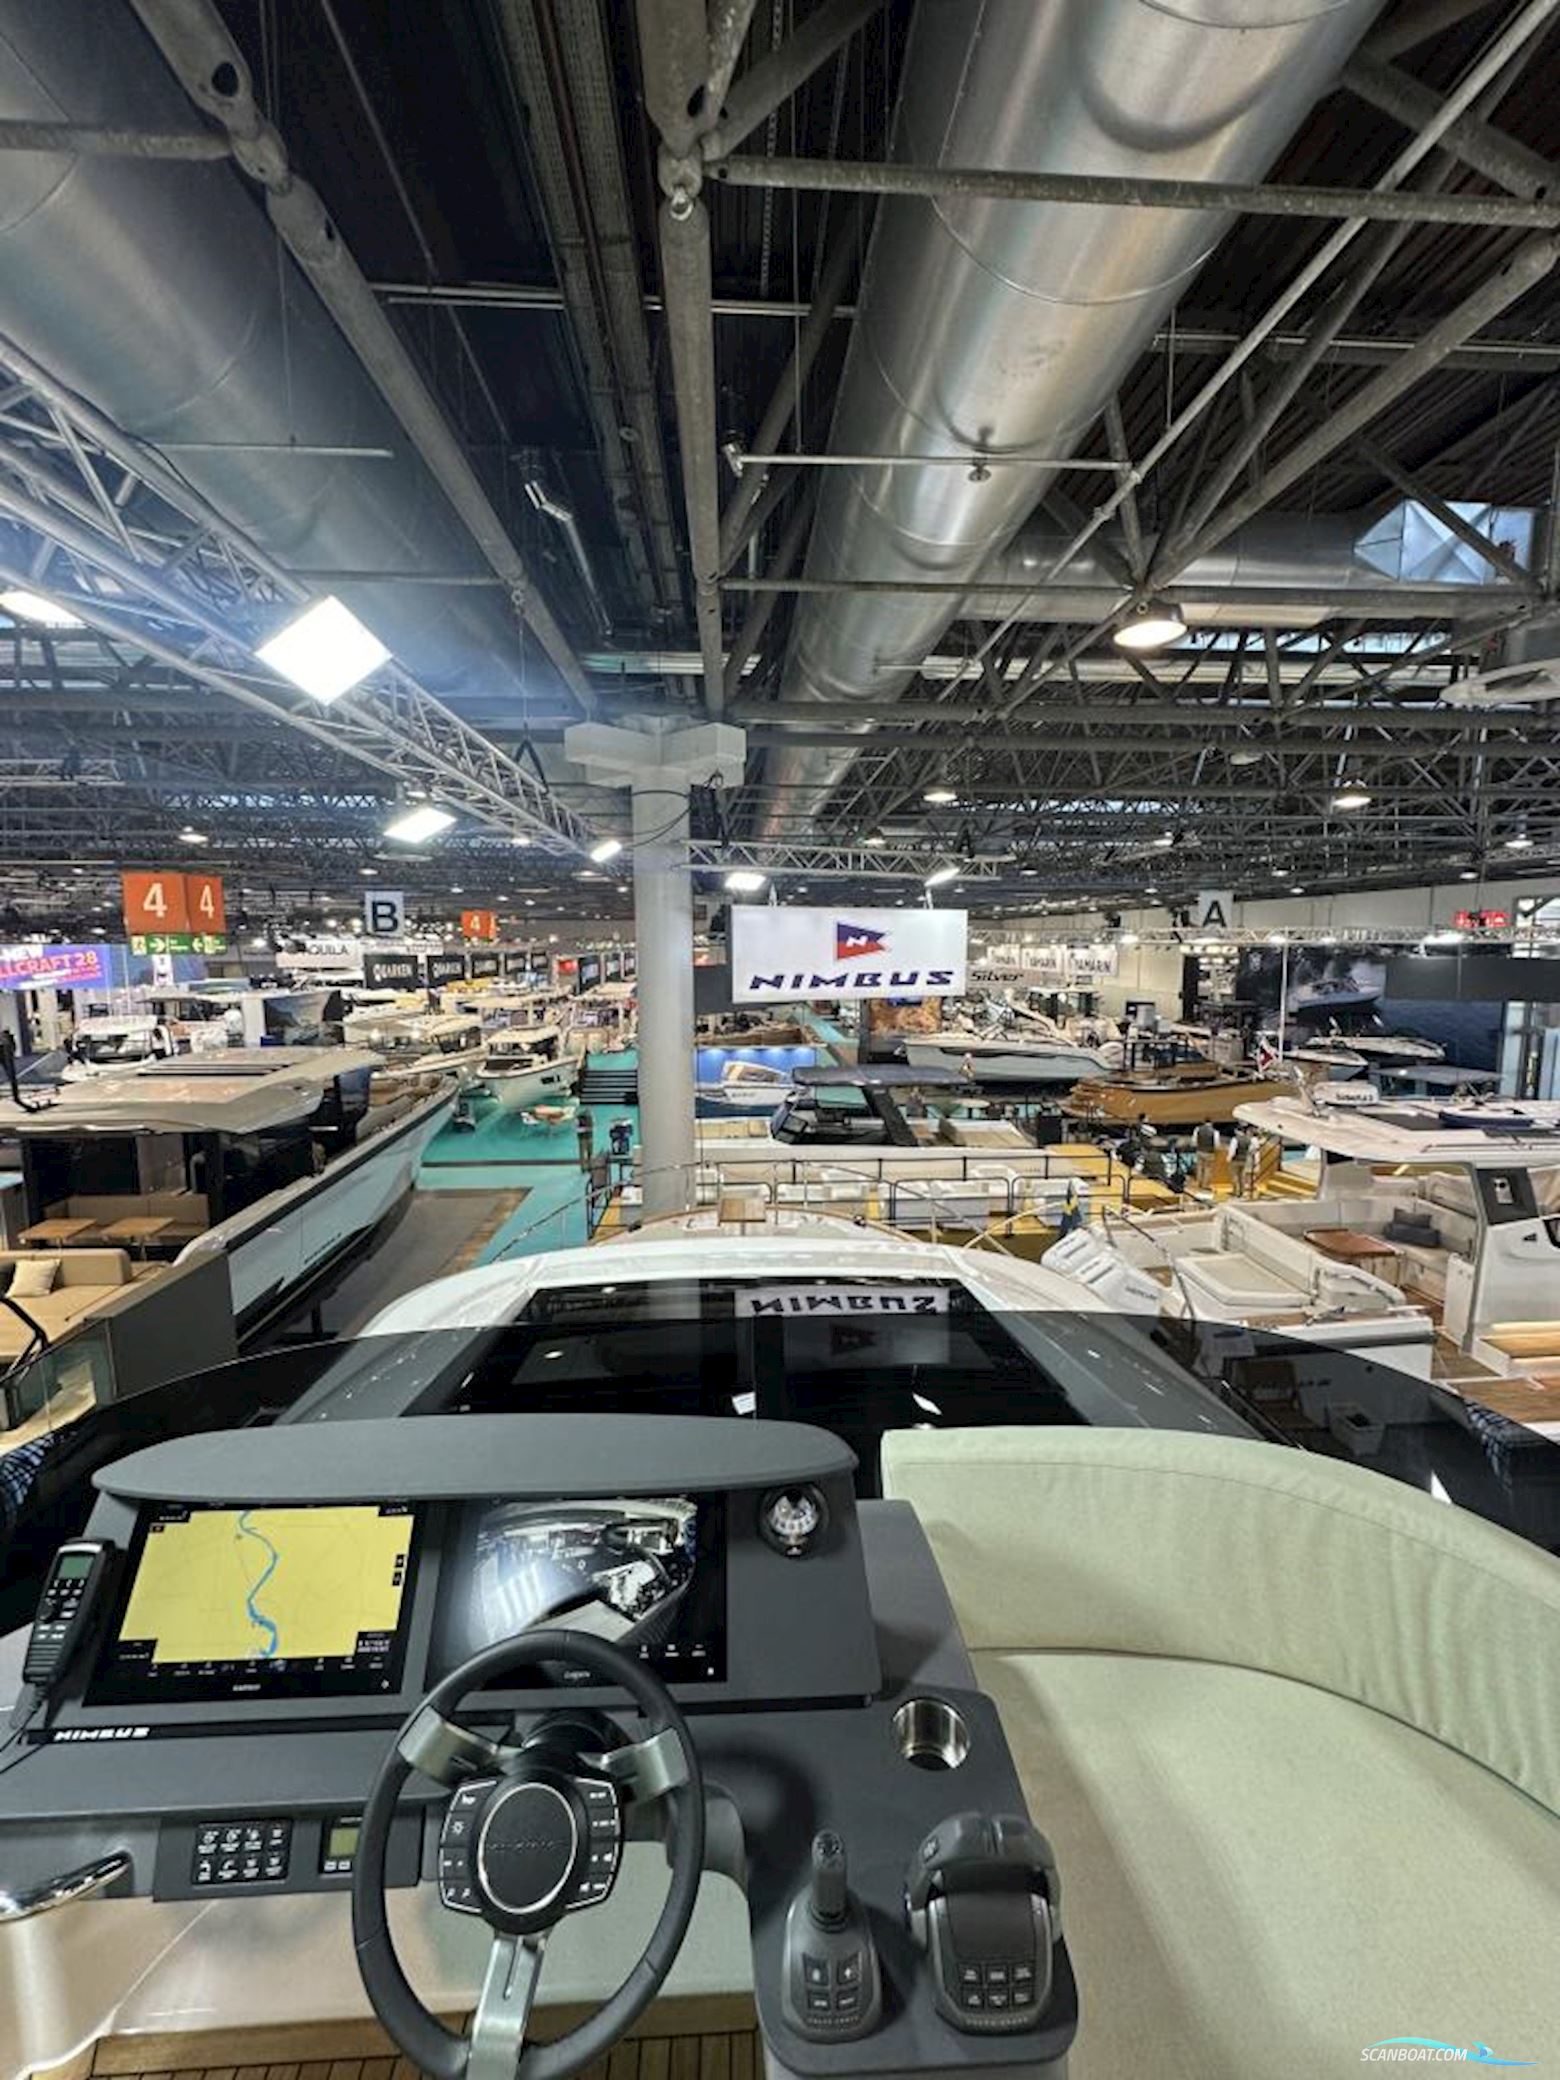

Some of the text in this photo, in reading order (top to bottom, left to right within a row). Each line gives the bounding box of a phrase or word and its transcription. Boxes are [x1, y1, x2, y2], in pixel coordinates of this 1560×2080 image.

[143, 882, 168, 918] 4
[199, 884, 215, 919] 4
[371, 901, 399, 932] B
[469, 915, 481, 931] 4
[1202, 900, 1227, 927] A
[749, 971, 954, 990] NIMBUS
[970, 970, 1024, 982] Silver
[53, 1726, 150, 1741] NIMBUS
